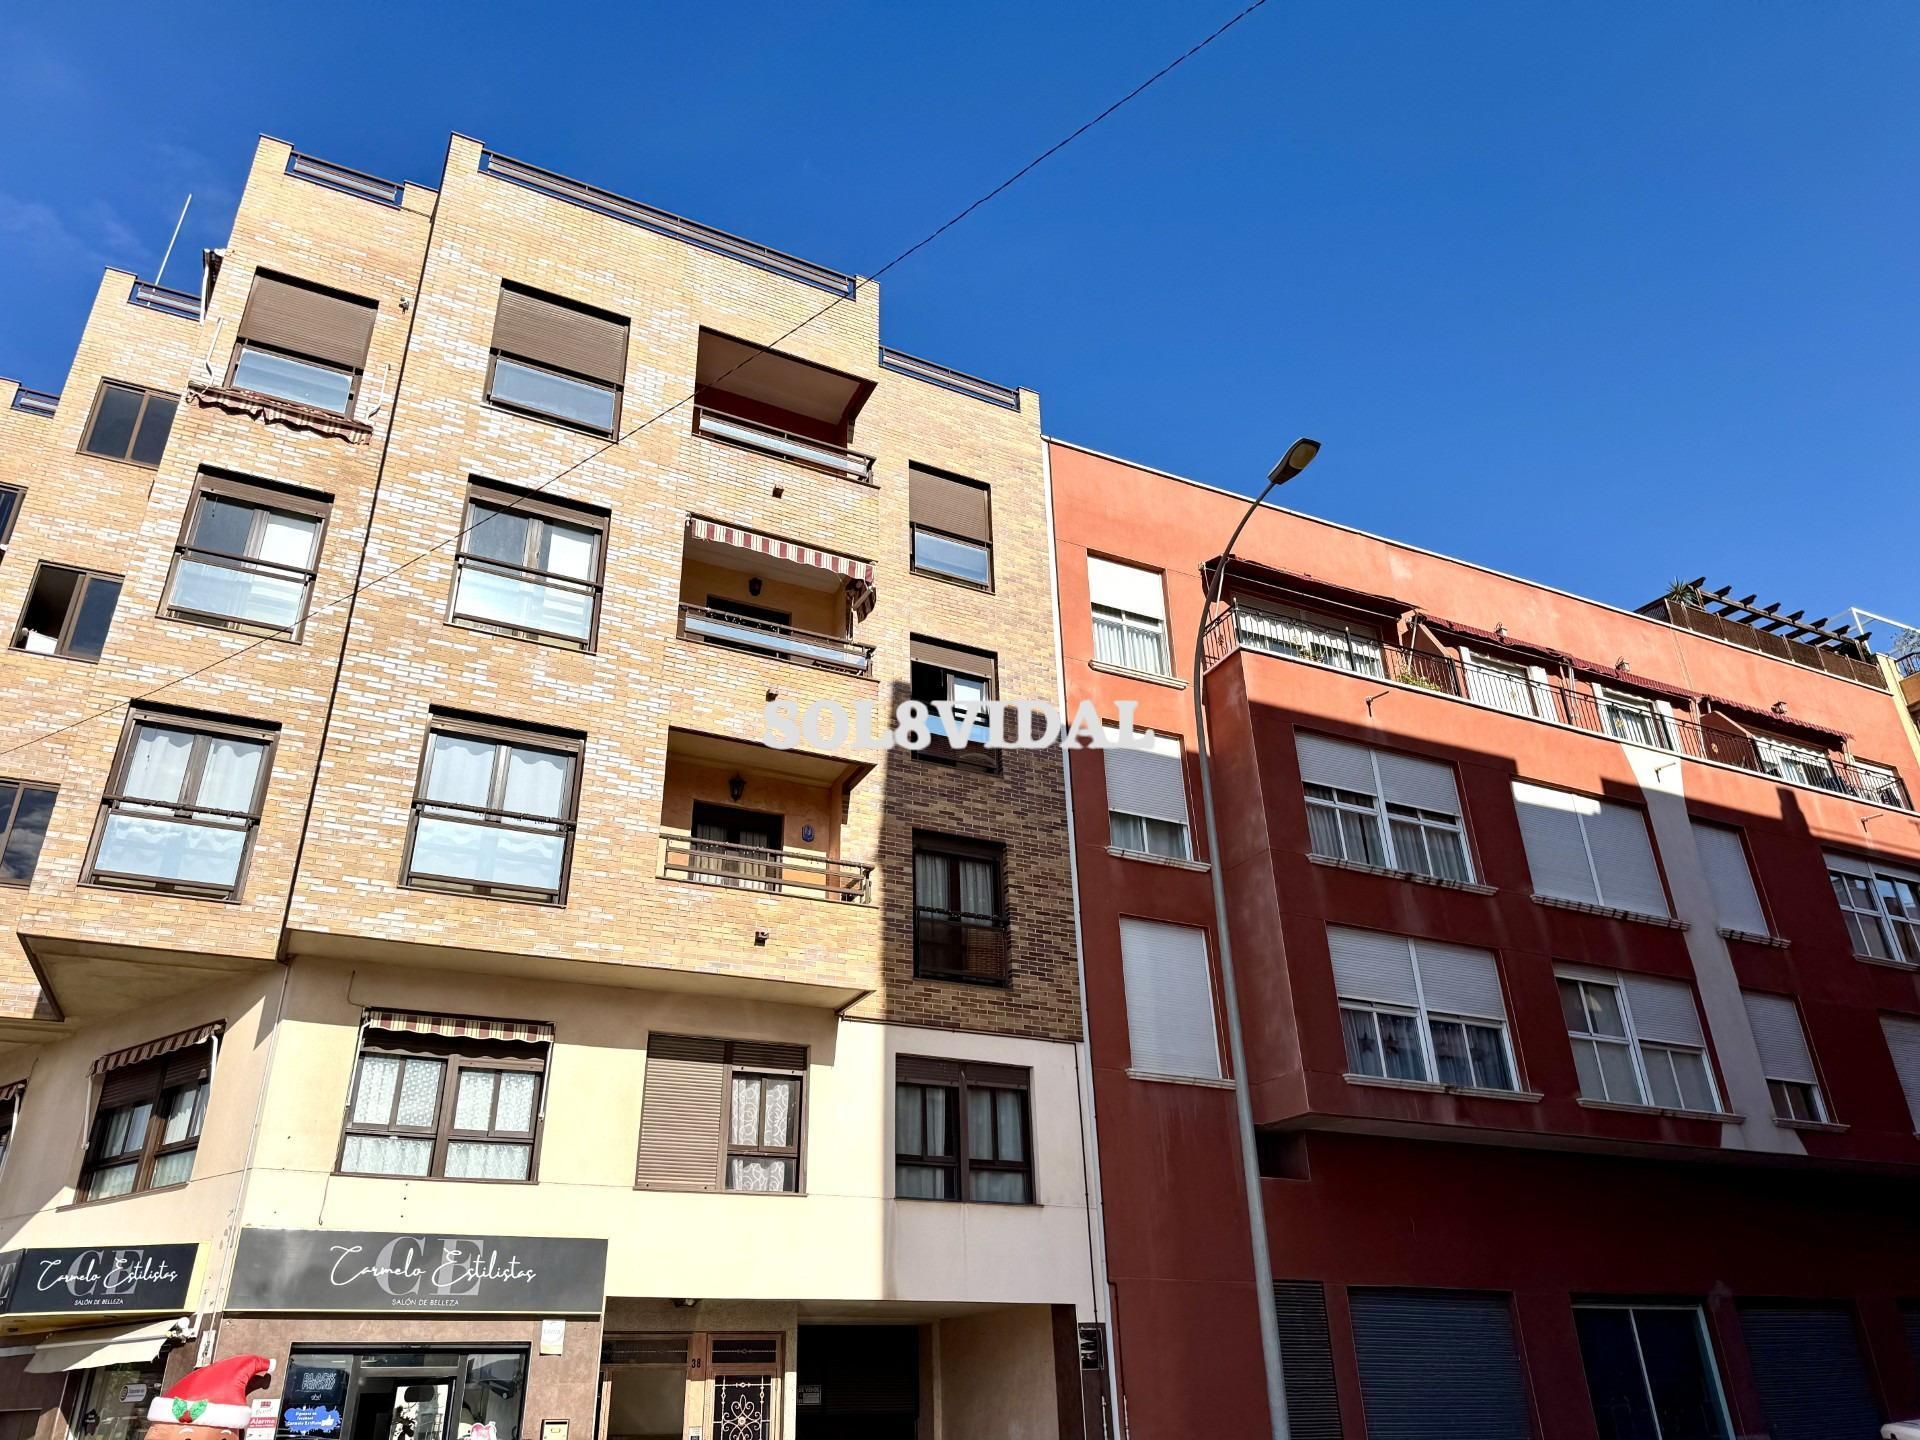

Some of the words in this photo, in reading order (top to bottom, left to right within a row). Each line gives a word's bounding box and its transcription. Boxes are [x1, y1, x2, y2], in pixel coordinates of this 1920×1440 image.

[37, 1258, 101, 1291] Carmelo
[103, 1256, 178, 1289] Estilistas
[67, 1250, 144, 1297] CE
[330, 1245, 427, 1286] Carmelo
[431, 1247, 537, 1287] Estilistas
[375, 1236, 484, 1296] CE
[391, 1297, 416, 1306] SALÓN
